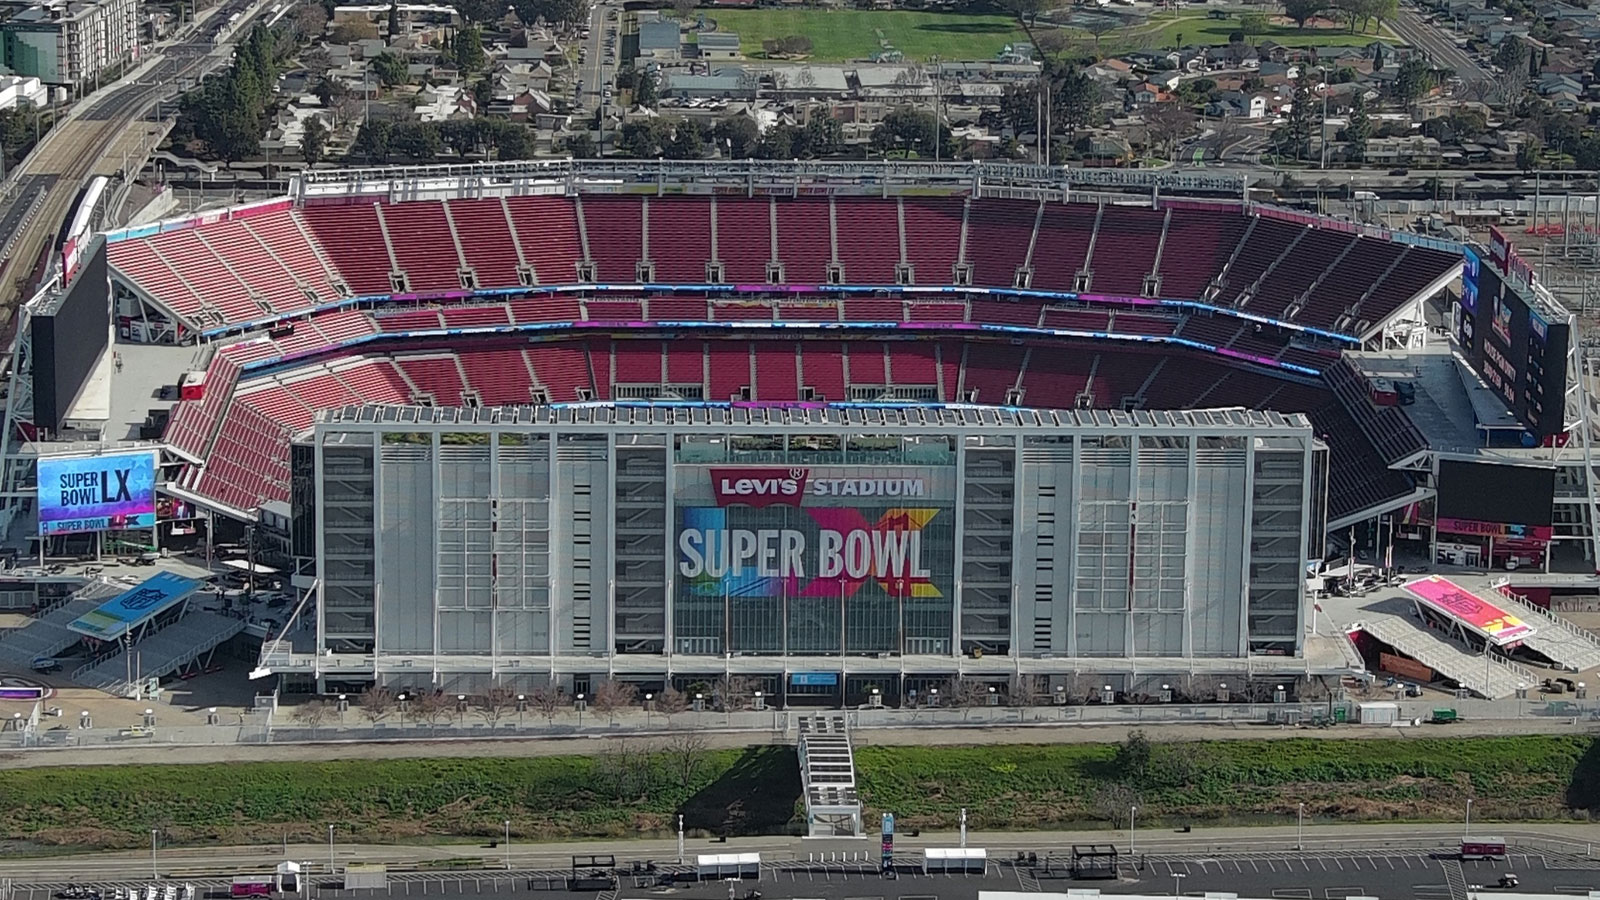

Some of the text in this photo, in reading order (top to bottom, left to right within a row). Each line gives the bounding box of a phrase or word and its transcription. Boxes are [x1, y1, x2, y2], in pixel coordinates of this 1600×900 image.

[60, 472, 98, 488] SUPER
[101, 469, 131, 503] LX
[813, 478, 924, 496] STADIUM
[61, 488, 99, 506] BOWL
[57, 519, 82, 532] SUPER
[85, 518, 106, 530] BOWL
[1453, 520, 1478, 533] SUPER
[1481, 523, 1503, 535] BOWL
[679, 528, 931, 579] SUPER BOWL
